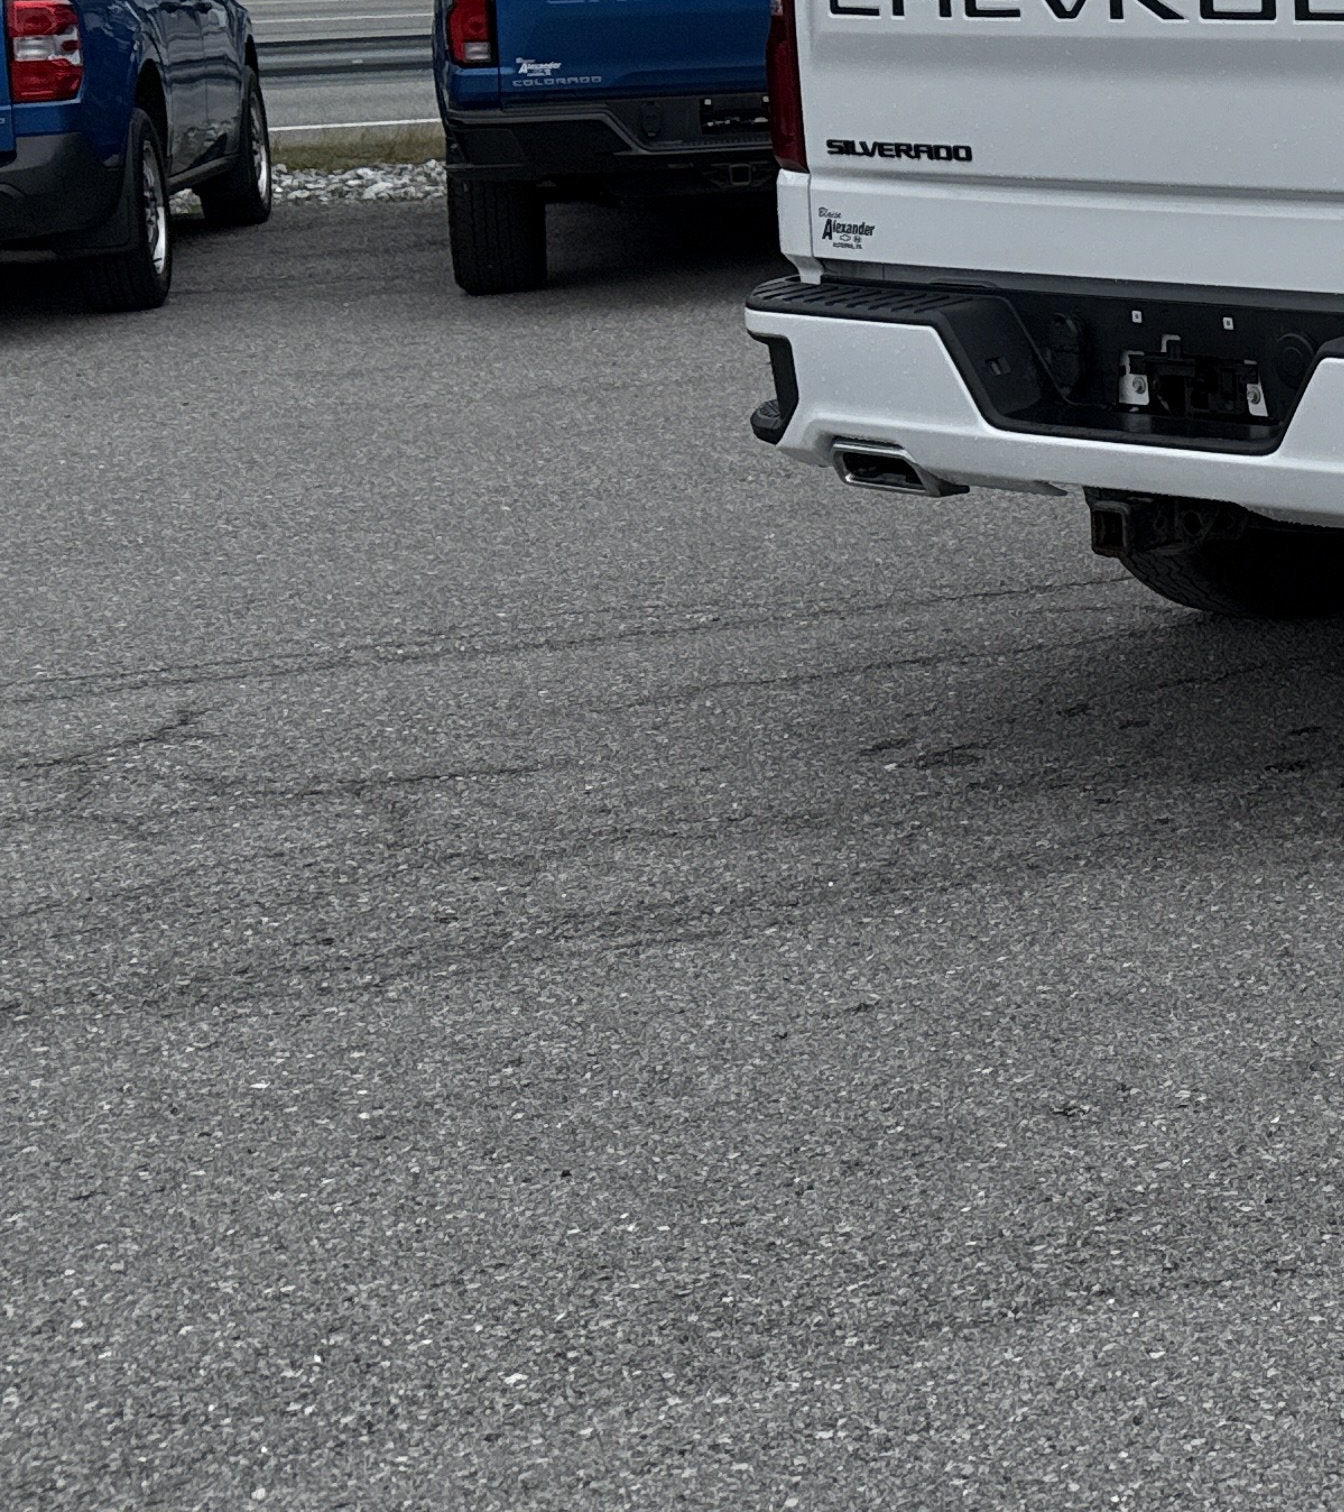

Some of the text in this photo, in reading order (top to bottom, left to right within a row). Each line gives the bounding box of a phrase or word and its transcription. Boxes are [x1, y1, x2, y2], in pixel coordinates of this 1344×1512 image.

[512, 76, 602, 87] COLORADO
[826, 139, 973, 162] SILVERADO
[822, 218, 876, 240] Alexander
